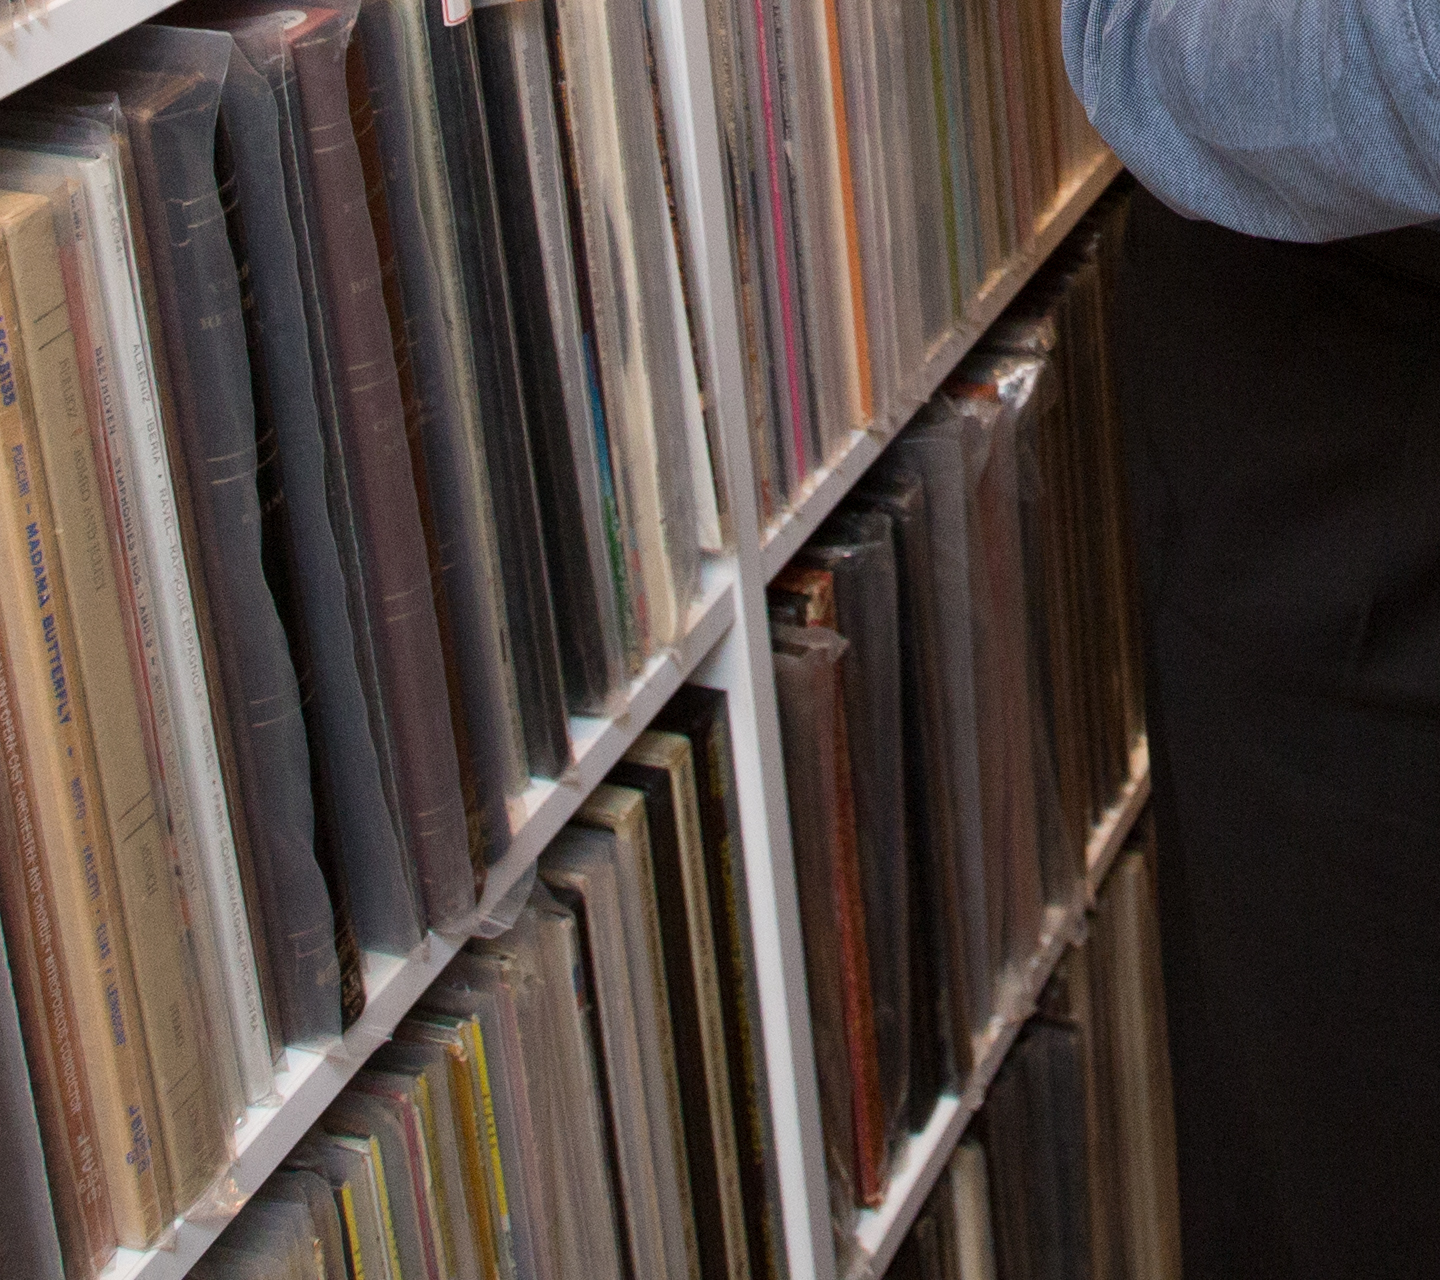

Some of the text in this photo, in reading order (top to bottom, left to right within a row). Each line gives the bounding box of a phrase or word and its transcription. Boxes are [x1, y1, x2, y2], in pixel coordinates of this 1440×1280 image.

[93, 346, 117, 436] BEETHOVEN
[112, 456, 137, 550] SYMPHONIES
[11, 444, 30, 495] PUCCINI
[24, 522, 51, 608] MADAMA
[39, 614, 71, 724] BUTTERFLY
[10, 789, 38, 866] ORCHESTRA
[25, 868, 43, 892] AND
[32, 895, 53, 944] CHORUS
[57, 1042, 85, 1113] CONDUCTOR
